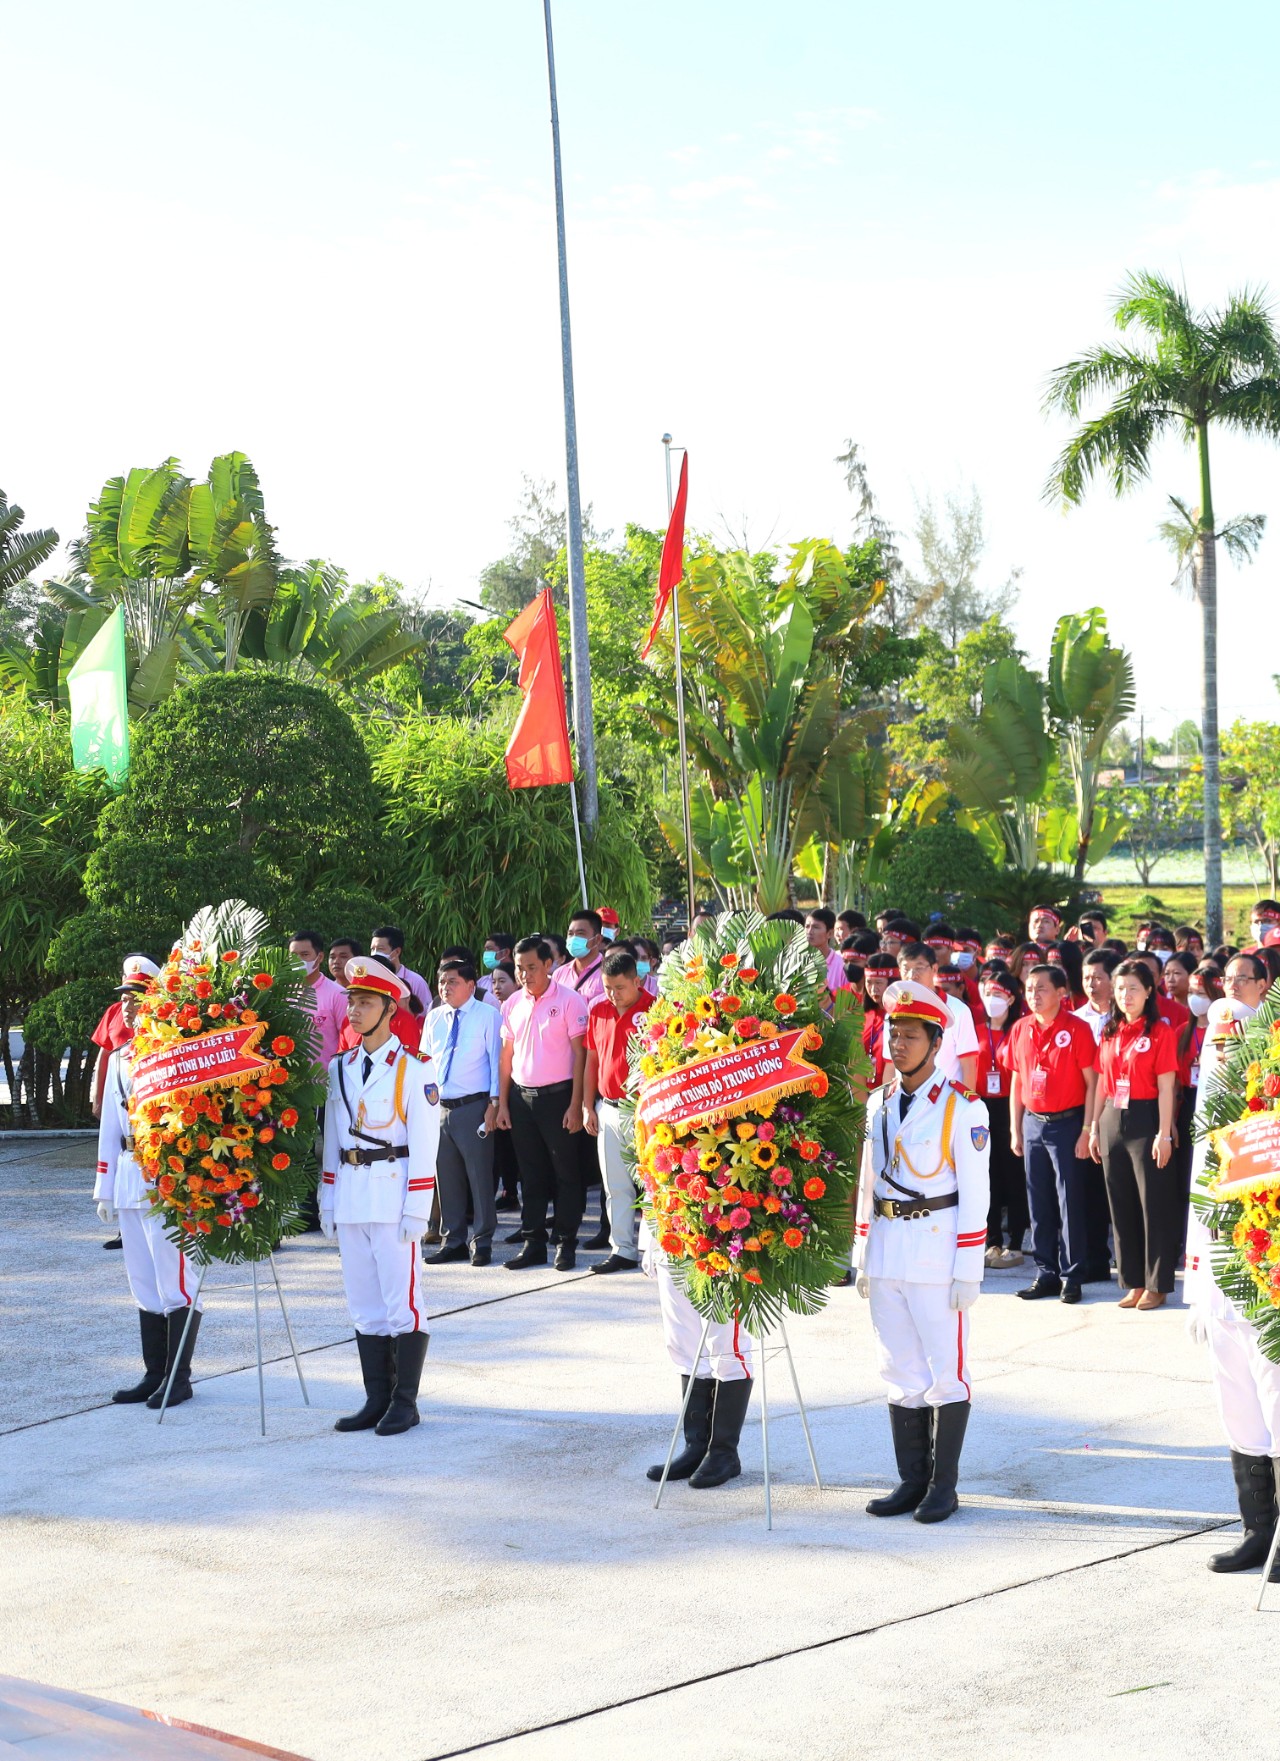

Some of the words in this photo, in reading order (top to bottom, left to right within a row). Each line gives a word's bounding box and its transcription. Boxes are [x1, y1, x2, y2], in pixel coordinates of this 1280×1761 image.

[201, 1036, 223, 1049] LIỆT
[177, 1056, 198, 1074] TỈNH
[197, 1053, 216, 1070] BẠC
[216, 1047, 236, 1064] LIÊU
[670, 1073, 688, 1086] CÁC
[689, 1065, 710, 1080] ANH
[710, 1054, 742, 1071] HÙNG
[743, 1045, 767, 1060] LIỆT
[769, 1039, 780, 1051] SĨ
[681, 1083, 711, 1104] TRÌNH
[708, 1073, 723, 1095] ĐỎ
[722, 1066, 756, 1090] TRUNG
[754, 1056, 783, 1077] ƯƠNG
[693, 1090, 744, 1111] Viếng
